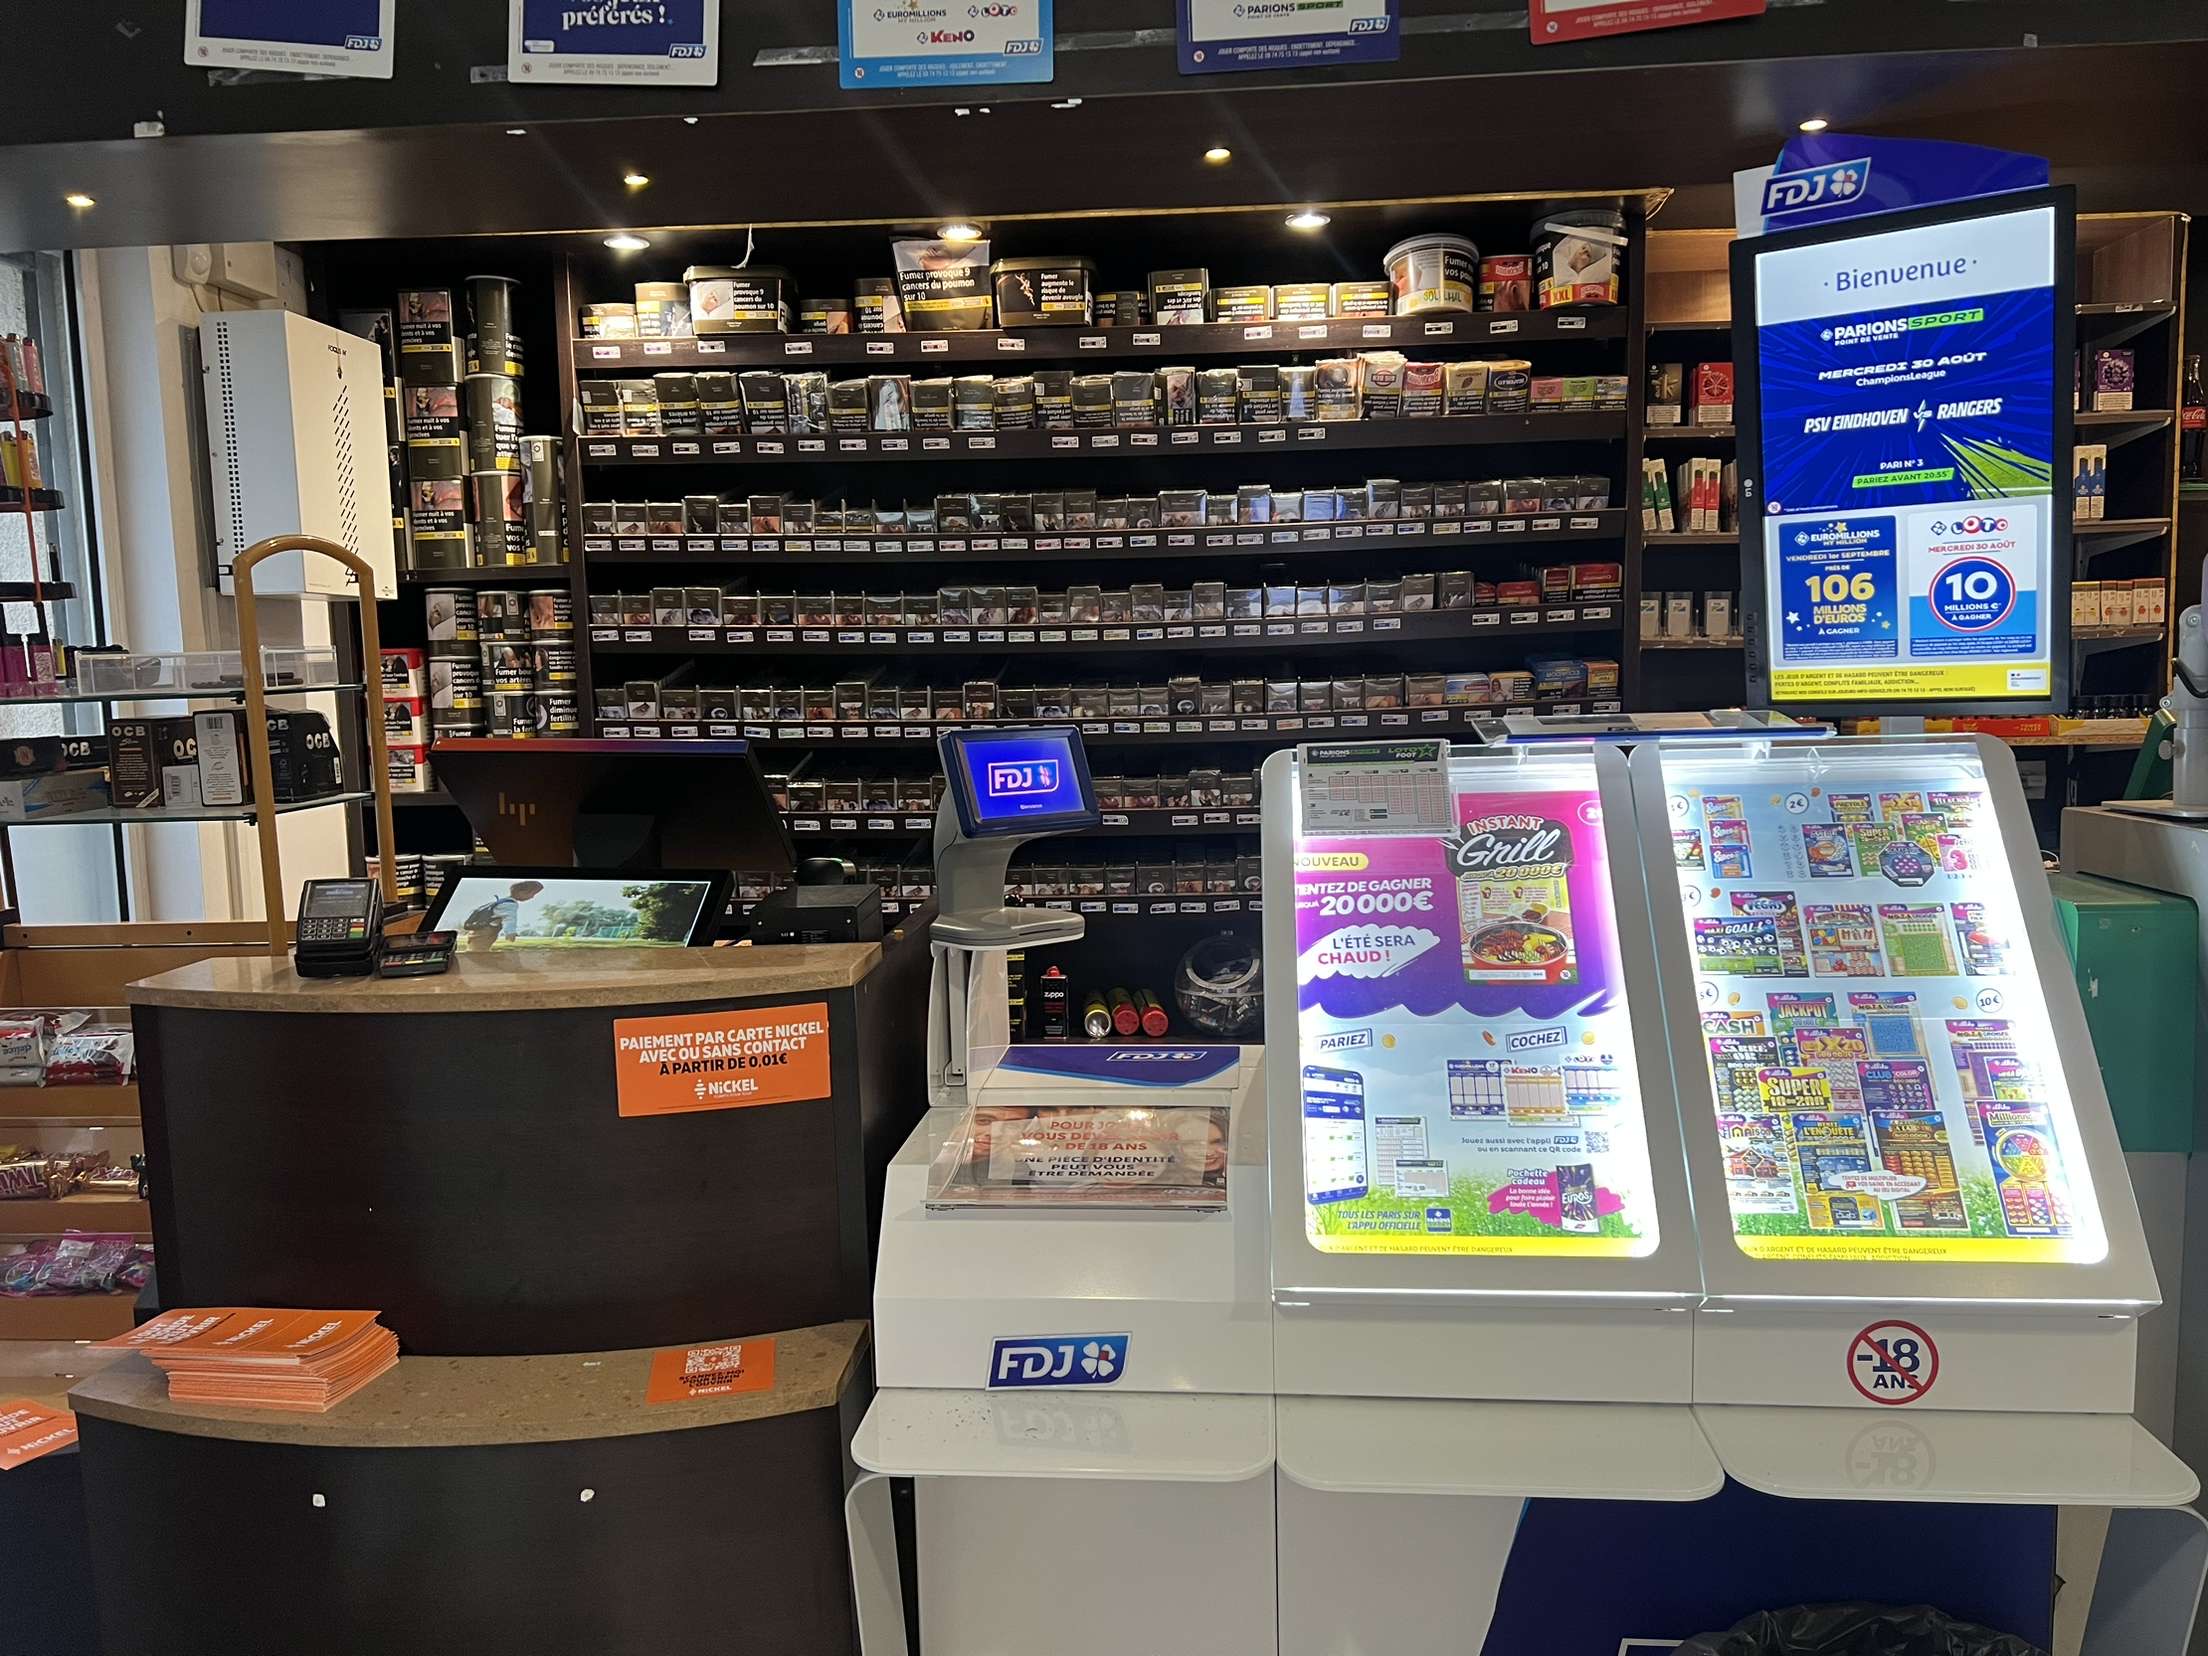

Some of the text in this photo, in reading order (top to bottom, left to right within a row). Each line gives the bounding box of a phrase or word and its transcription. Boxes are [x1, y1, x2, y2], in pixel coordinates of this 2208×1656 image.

[887, 9, 947, 18] EUROMILLIONS
[1247, 3, 1295, 15] PARIONS
[562, 4, 666, 30] préférés !
[1766, 174, 1826, 209] FDJ
[1444, 255, 1467, 267] Fumer
[900, 268, 970, 281] Fumer provoque 9
[1444, 267, 1459, 277] vos
[1836, 256, 1967, 291] Bienvenue
[902, 279, 975, 291] cancers du poumon
[903, 292, 926, 302] sur 10
[1552, 288, 1571, 302] XXL
[1834, 309, 1980, 340] PARIONS SPORT
[1834, 333, 1899, 346] POINT DE VENTE
[327, 344, 341, 354] FOCUS
[1818, 352, 1987, 380] MERCREDI 30 AOÛT
[1804, 398, 2003, 433] PSV EINDHOVEN RANGERS
[1880, 459, 1924, 470] PARI 3
[1857, 473, 1922, 486] PARIEZ AVANT
[1951, 515, 2009, 535] LOTO
[1811, 530, 1880, 542] EUROMILLIONS
[1928, 540, 2016, 553] MERCREDI 30 AOÛT
[1786, 549, 1890, 562] VENDREDI SEPTEMBRE
[1805, 572, 1875, 603] 106
[1945, 570, 1997, 600] 10
[1813, 603, 1867, 615] MILLIONS
[1944, 603, 1988, 612] MILLIONS
[1959, 612, 1992, 621] GAGNER
[1826, 626, 1860, 634] GAGNER
[111, 726, 146, 737] OCB
[306, 732, 331, 750] OCB
[994, 767, 1032, 789] FDJ
[1467, 815, 1545, 836] INSTANT
[1457, 828, 1561, 867] Grill
[1347, 877, 1431, 892] DE GAGNER
[1333, 933, 1416, 949] L'ÉTÉ SERA
[1318, 950, 1391, 965] CHAUD !
[1778, 1003, 1827, 1018] JACKPOT
[1702, 1019, 1756, 1034] CASH
[620, 1021, 824, 1050] PAIEMENT PAR CARTE NICKEL
[1320, 1033, 1366, 1050] PARIEZ
[1511, 1031, 1561, 1048] COCHEZ
[639, 1037, 807, 1064] AVEC OU SANS CONTACT
[1116, 1052, 1169, 1061] FDJ
[659, 1060, 670, 1075] À
[672, 1058, 724, 1075] PARTIR
[727, 1056, 746, 1069] DE
[1866, 1070, 1892, 1080] CLUB
[1767, 1078, 1822, 1097] SUPER
[1050, 1121, 1095, 1131] POUR
[1021, 1132, 1067, 1141] VOUS
[1065, 1143, 1085, 1151] DE
[1089, 1143, 1109, 1151] 18
[1092, 1154, 1176, 1163] D'IDENTITÉ
[1028, 1169, 1154, 1177] ÊTRE DEMANDÉE
[1507, 1168, 1549, 1178] Pochette
[1511, 1177, 1546, 1185] cadeau
[1338, 1210, 1421, 1219] TOUS LES PARIS SUR
[1347, 1221, 1421, 1231] L'APPLI OFFICIELLE
[1883, 1245, 1901, 1254] ÊTRE
[1902, 1247, 1946, 1255] DANGEREUX
[1857, 1338, 1920, 1373] -18
[997, 1345, 1072, 1380] FDJ
[1873, 1374, 1919, 1390] ANS
